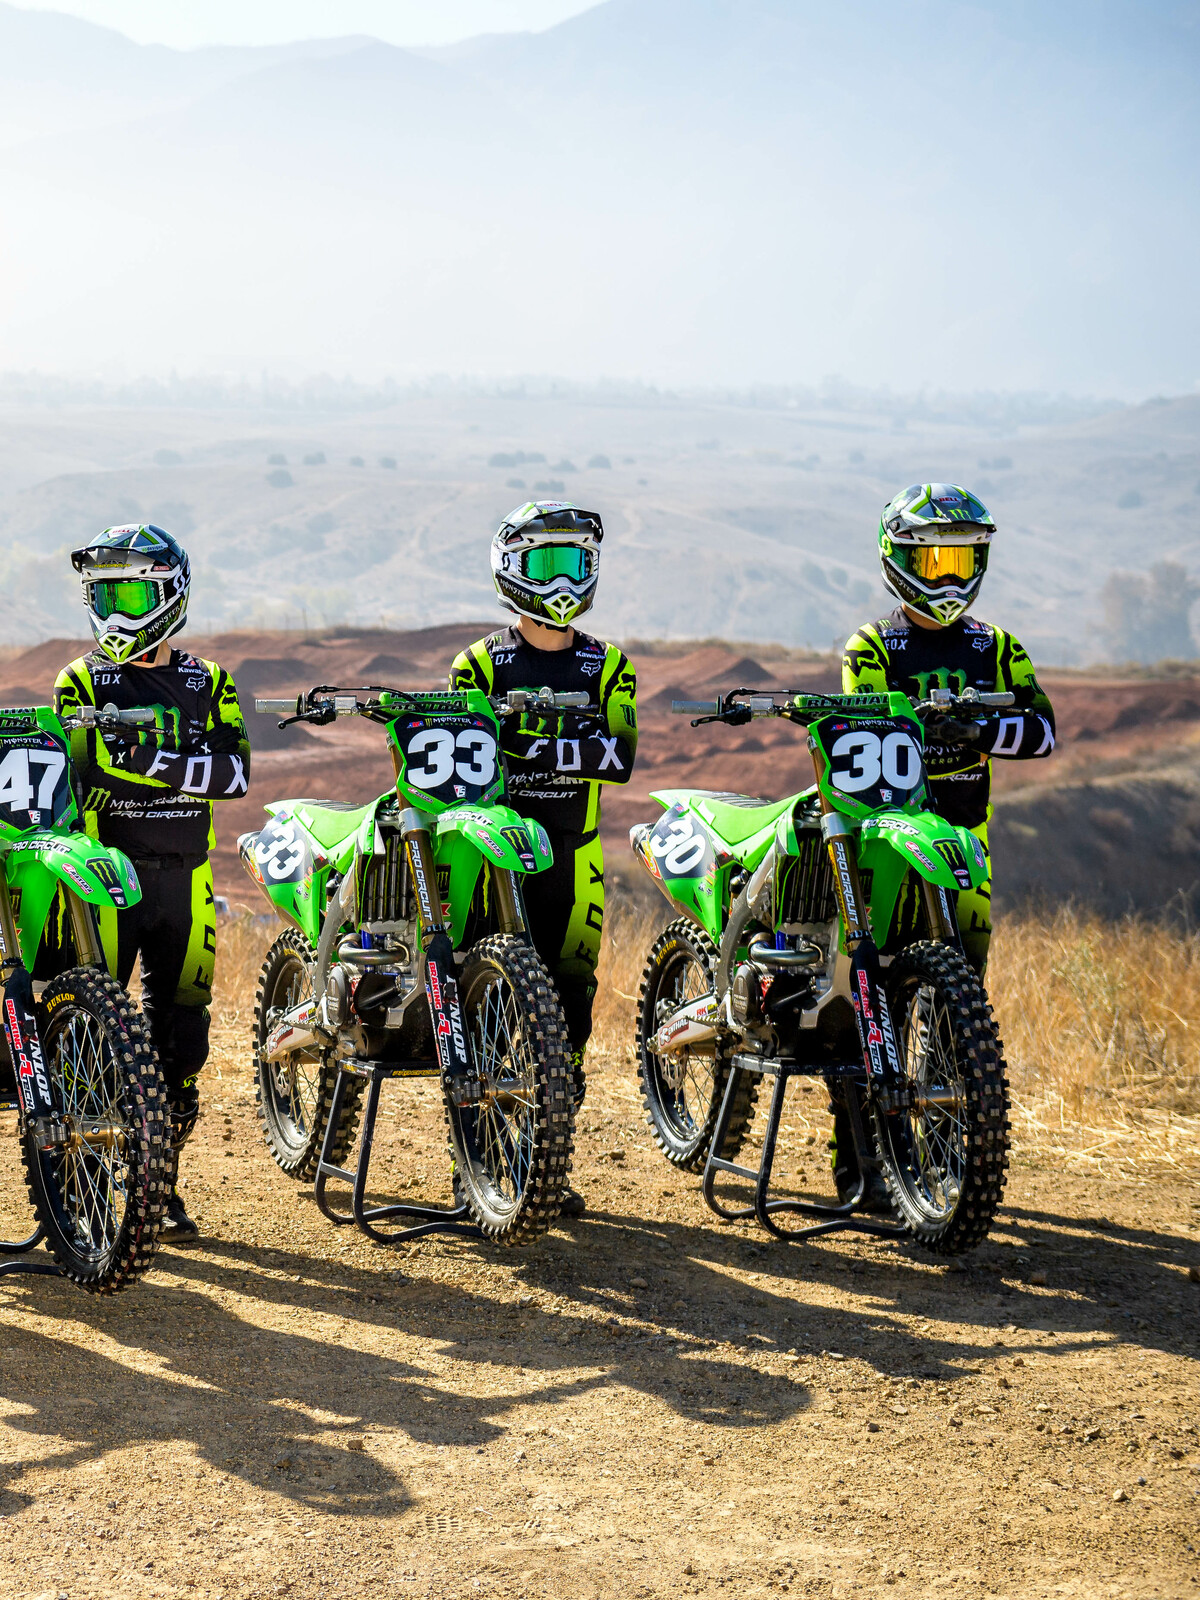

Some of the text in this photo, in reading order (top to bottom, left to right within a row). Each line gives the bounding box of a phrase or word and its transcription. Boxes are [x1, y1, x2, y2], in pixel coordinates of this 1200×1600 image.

[490, 653, 516, 665] OX
[885, 638, 908, 650] FOX
[94, 673, 121, 685] FOX
[857, 720, 896, 728] MONSTER
[990, 714, 1055, 755] OX
[407, 728, 497, 790] 33
[526, 738, 624, 771] FOX
[831, 730, 922, 793] 30
[145, 750, 248, 794] FOX
[936, 774, 983, 782] RCUIT
[519, 790, 577, 799] CIRCUIT
[110, 810, 201, 819] PRO CIRCUIT
[454, 811, 494, 827] CIRCUIT
[878, 819, 920, 836] CIRCUIT
[28, 839, 72, 853] CIRCUIT
[254, 826, 306, 880] 33
[649, 820, 706, 875] 30
[410, 840, 433, 921] PRO CIRCUIT
[834, 841, 859, 925] PRO CIRCUIT
[574, 860, 604, 969] FOX
[655, 938, 677, 966] DUNLOP
[428, 961, 442, 1010] BRAKING
[857, 969, 874, 1019] BRAKING
[46, 991, 76, 1013] DUNLOP
[298, 1012, 309, 1022] RK
[696, 1006, 707, 1016] RK
[5, 998, 23, 1051] BRAKING
[875, 984, 900, 1074] DUNLOP
